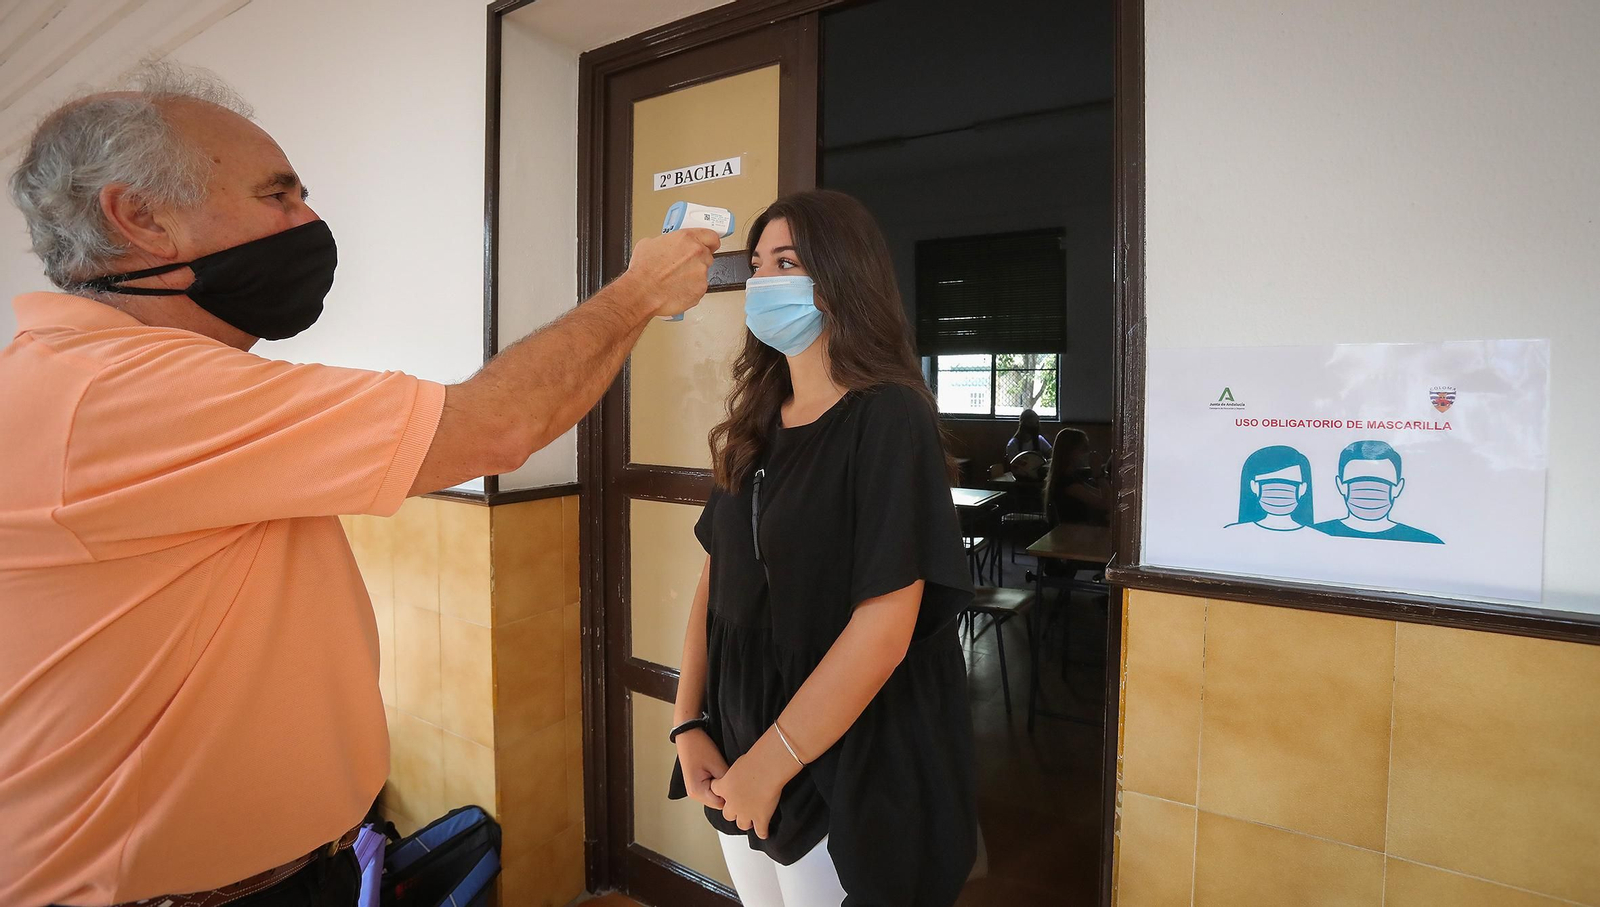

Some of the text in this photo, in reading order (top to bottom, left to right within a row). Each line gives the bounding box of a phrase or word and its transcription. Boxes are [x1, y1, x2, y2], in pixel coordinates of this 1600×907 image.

[660, 161, 734, 188] 2º BACH. A
[1235, 418, 1452, 431] USO OBLIGATORIO DE MASCARILLA
